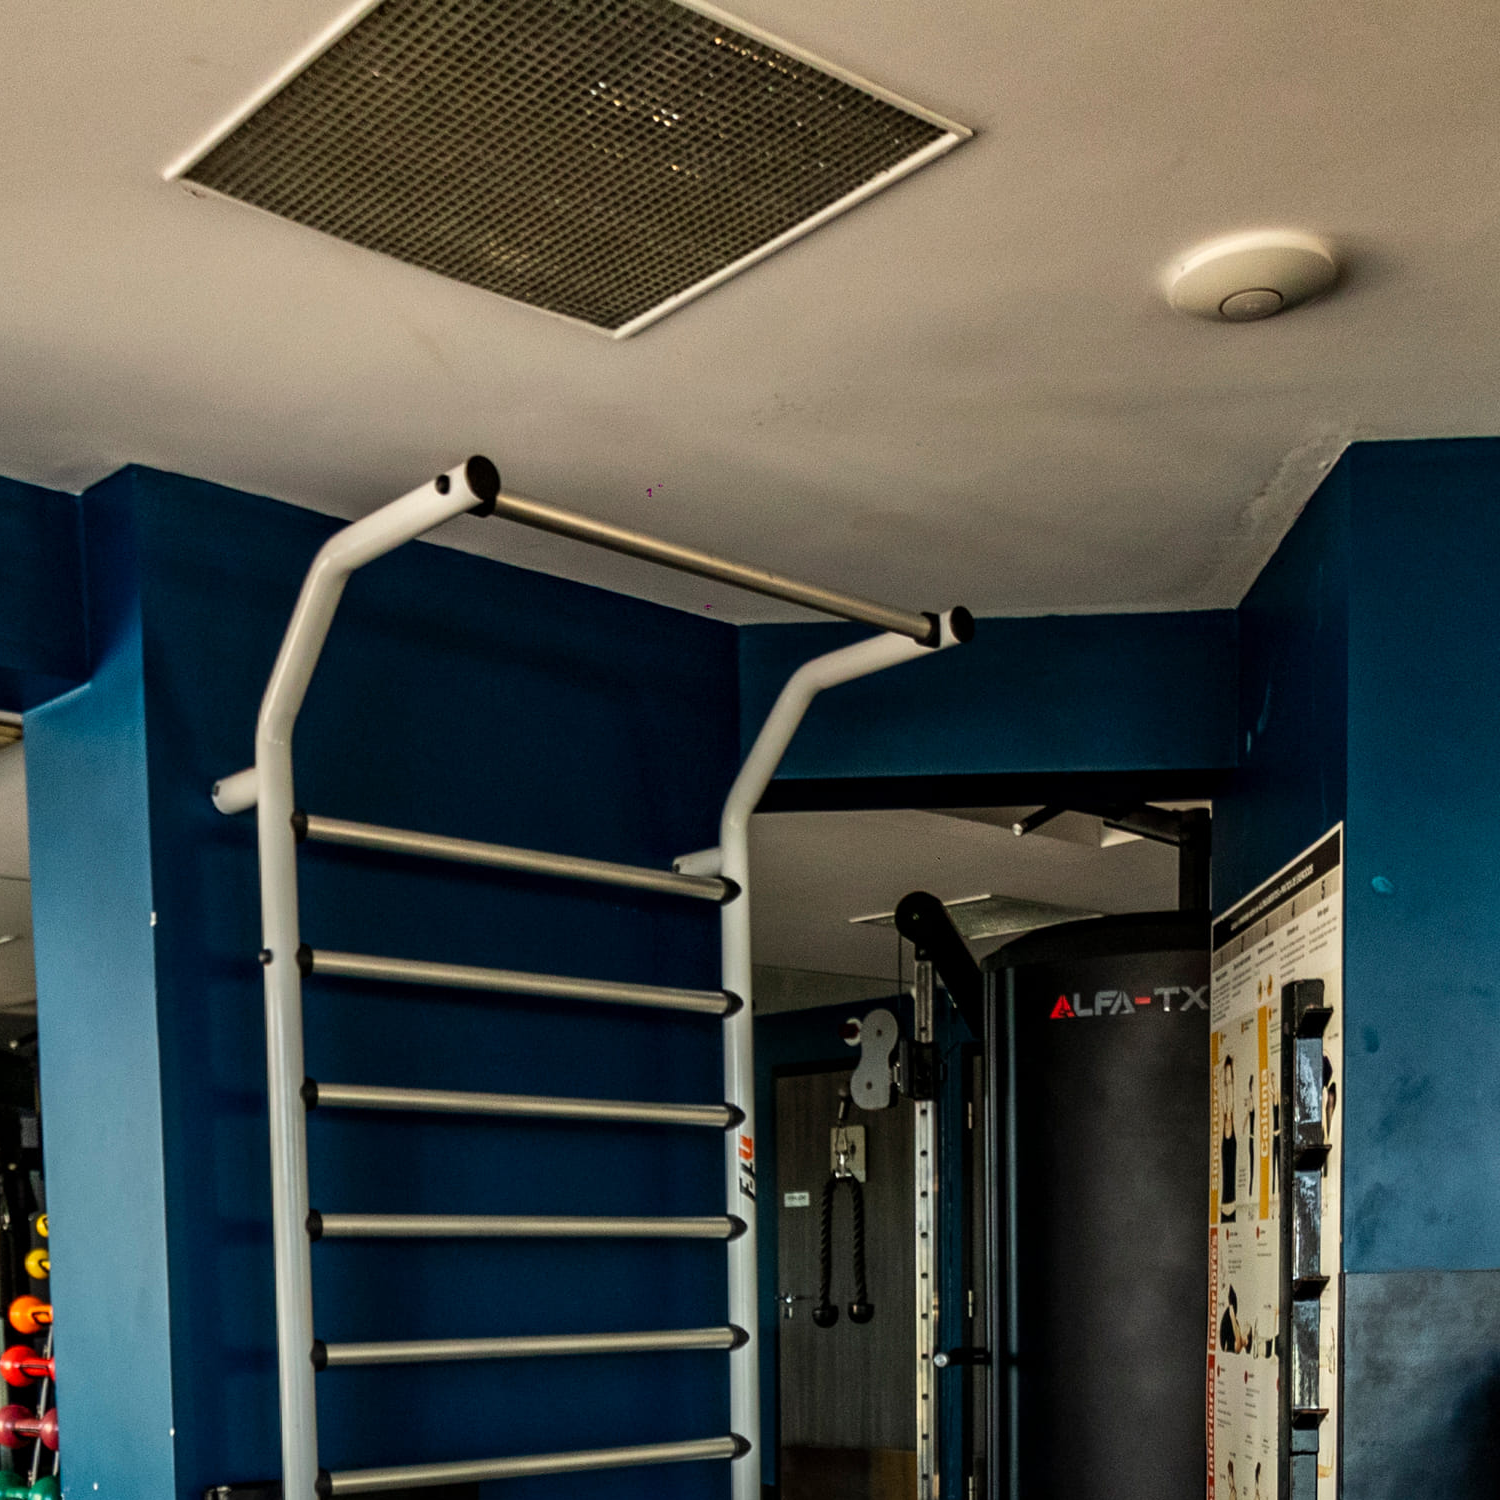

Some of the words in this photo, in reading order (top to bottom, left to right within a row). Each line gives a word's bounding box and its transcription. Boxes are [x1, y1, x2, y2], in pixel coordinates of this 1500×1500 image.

[1049, 984, 1208, 1020] ALFA-TX
[1261, 1069, 1269, 1158] Coluna
[1209, 1234, 1218, 1344] Inferiores
[1208, 1368, 1216, 1477] Inferiores
